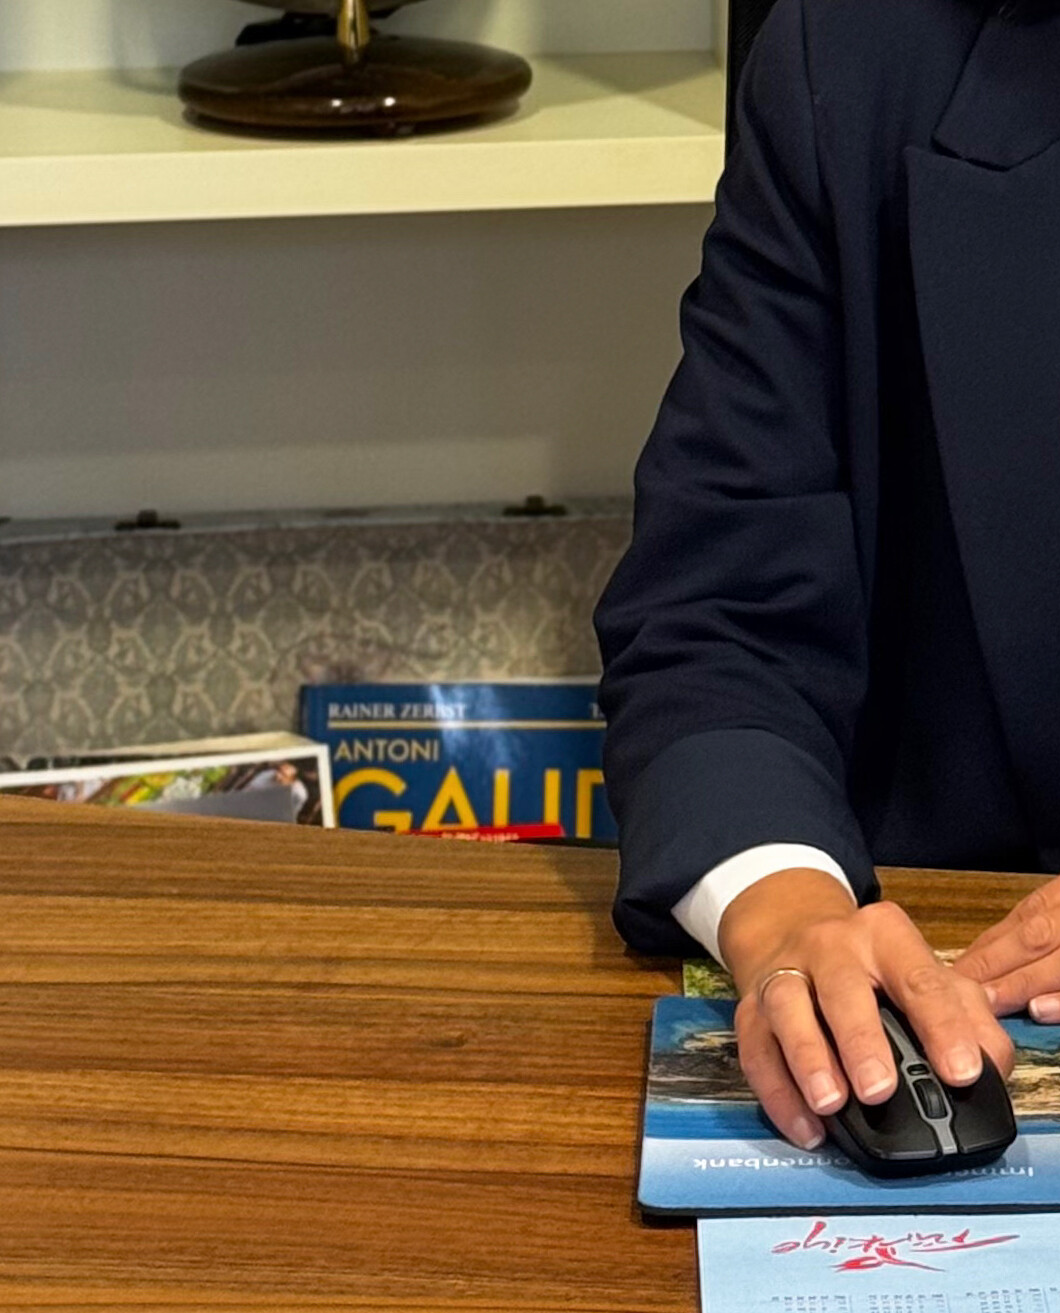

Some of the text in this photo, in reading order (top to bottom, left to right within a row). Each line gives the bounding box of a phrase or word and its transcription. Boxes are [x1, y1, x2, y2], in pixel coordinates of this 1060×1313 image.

[327, 702, 396, 719] RAINER
[334, 739, 440, 763] ANTONI
[693, 1157, 851, 1171] onnenbank
